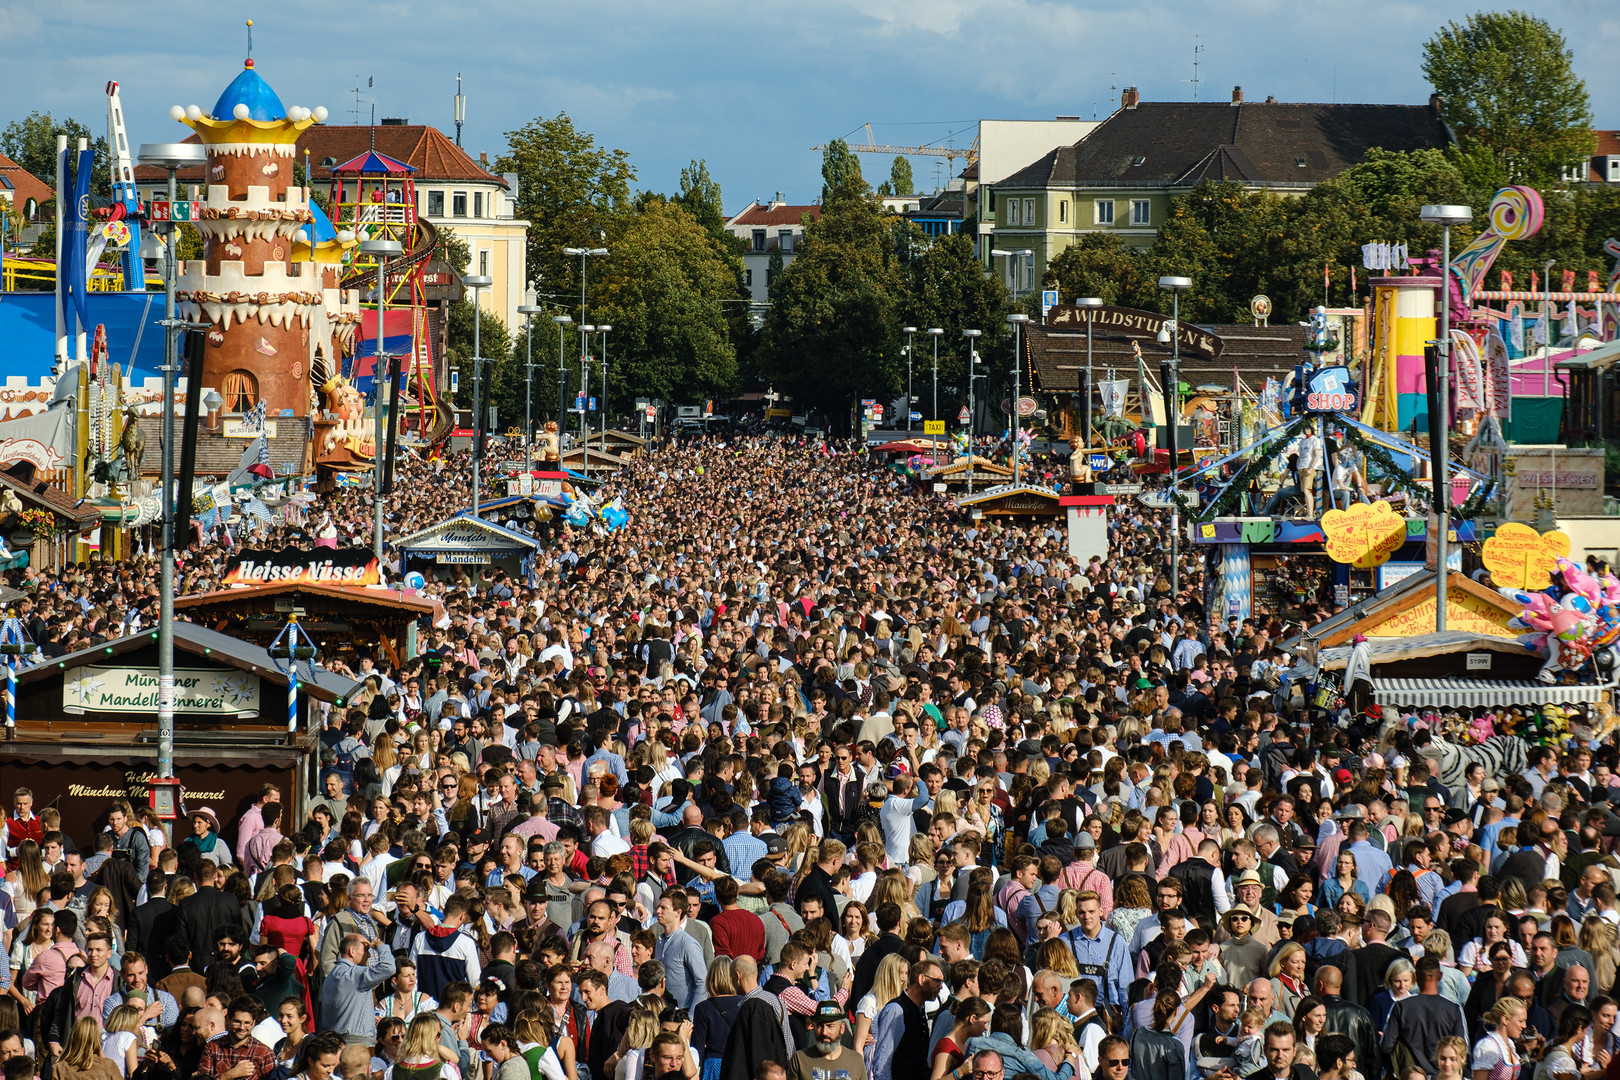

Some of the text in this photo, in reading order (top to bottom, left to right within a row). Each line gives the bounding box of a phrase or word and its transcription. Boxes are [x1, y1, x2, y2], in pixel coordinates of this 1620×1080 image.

[1307, 393, 1356, 410] SHOP
[1092, 458, 1107, 468] WC
[1327, 510, 1373, 526] Gebrannte
[1360, 516, 1399, 531] Mandeln
[441, 531, 487, 544] Mandeln
[444, 555, 483, 563] Mandeln
[237, 559, 366, 581] Heisse Nüsse
[125, 673, 200, 688] Münner
[100, 692, 225, 708] Mandelbennerei
[68, 783, 127, 797] Münchner
